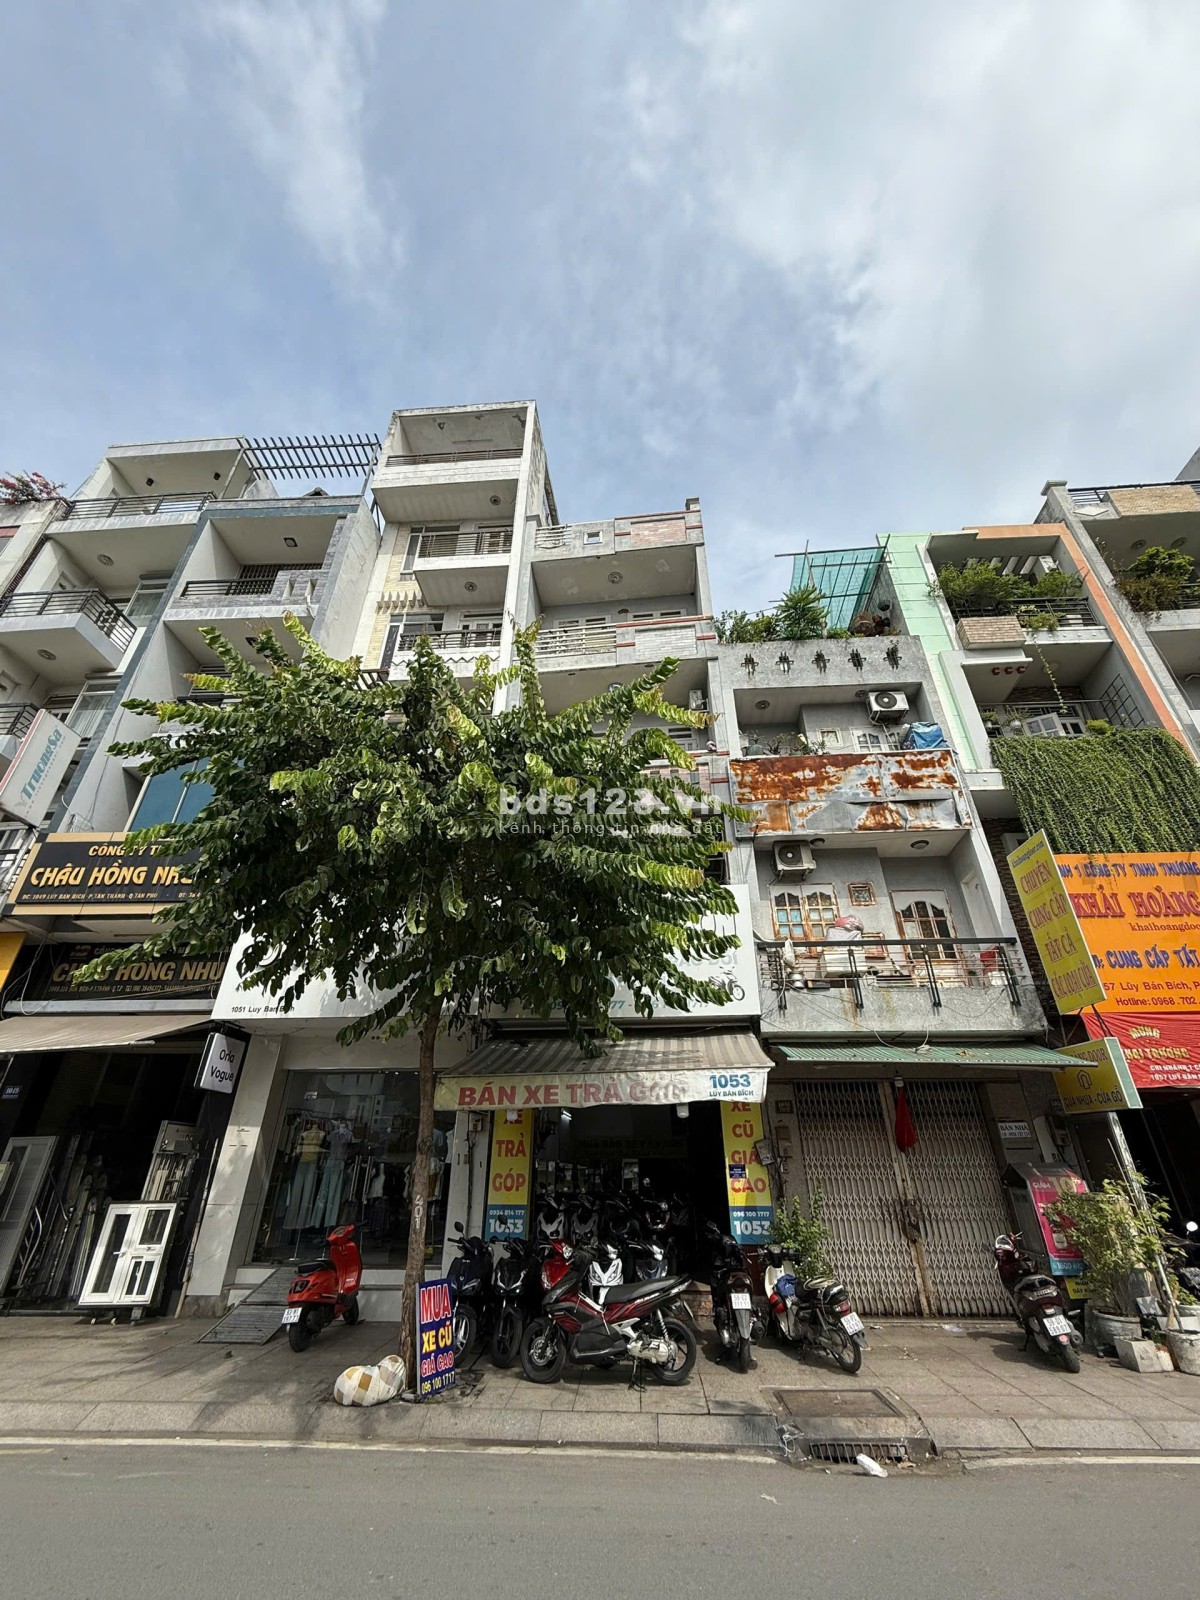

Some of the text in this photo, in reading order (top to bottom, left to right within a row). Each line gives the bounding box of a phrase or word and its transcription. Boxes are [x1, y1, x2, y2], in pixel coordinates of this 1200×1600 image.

[30, 863, 87, 888] CHÂU
[88, 859, 148, 888] HỒNG
[1111, 863, 1127, 877] TY
[1129, 862, 1159, 877] TNHH
[1068, 884, 1126, 918] KHẢI
[1028, 902, 1052, 931] CUNG
[1106, 949, 1143, 969] CUNG
[1144, 943, 1170, 969] CẤP
[1119, 981, 1139, 992] Lũy
[1143, 980, 1164, 991] Bán
[1115, 997, 1151, 1006] Hotline:
[210, 1065, 235, 1083] Vogue
[709, 1074, 751, 1089] 1053
[458, 1082, 518, 1107] BÁN
[524, 1083, 560, 1105] XE
[566, 1075, 625, 1103] TRẢ
[731, 1120, 755, 1138] CŨ
[495, 1132, 527, 1157] TRẢ
[492, 1168, 526, 1192] GÓP
[730, 1177, 767, 1193] CAO
[734, 1220, 771, 1235] 1053
[420, 1283, 452, 1324] MUA
[422, 1320, 453, 1354] XE CŨ
[421, 1351, 454, 1377] GIÁ CAO
[421, 1371, 455, 1394] 096 100 1717
